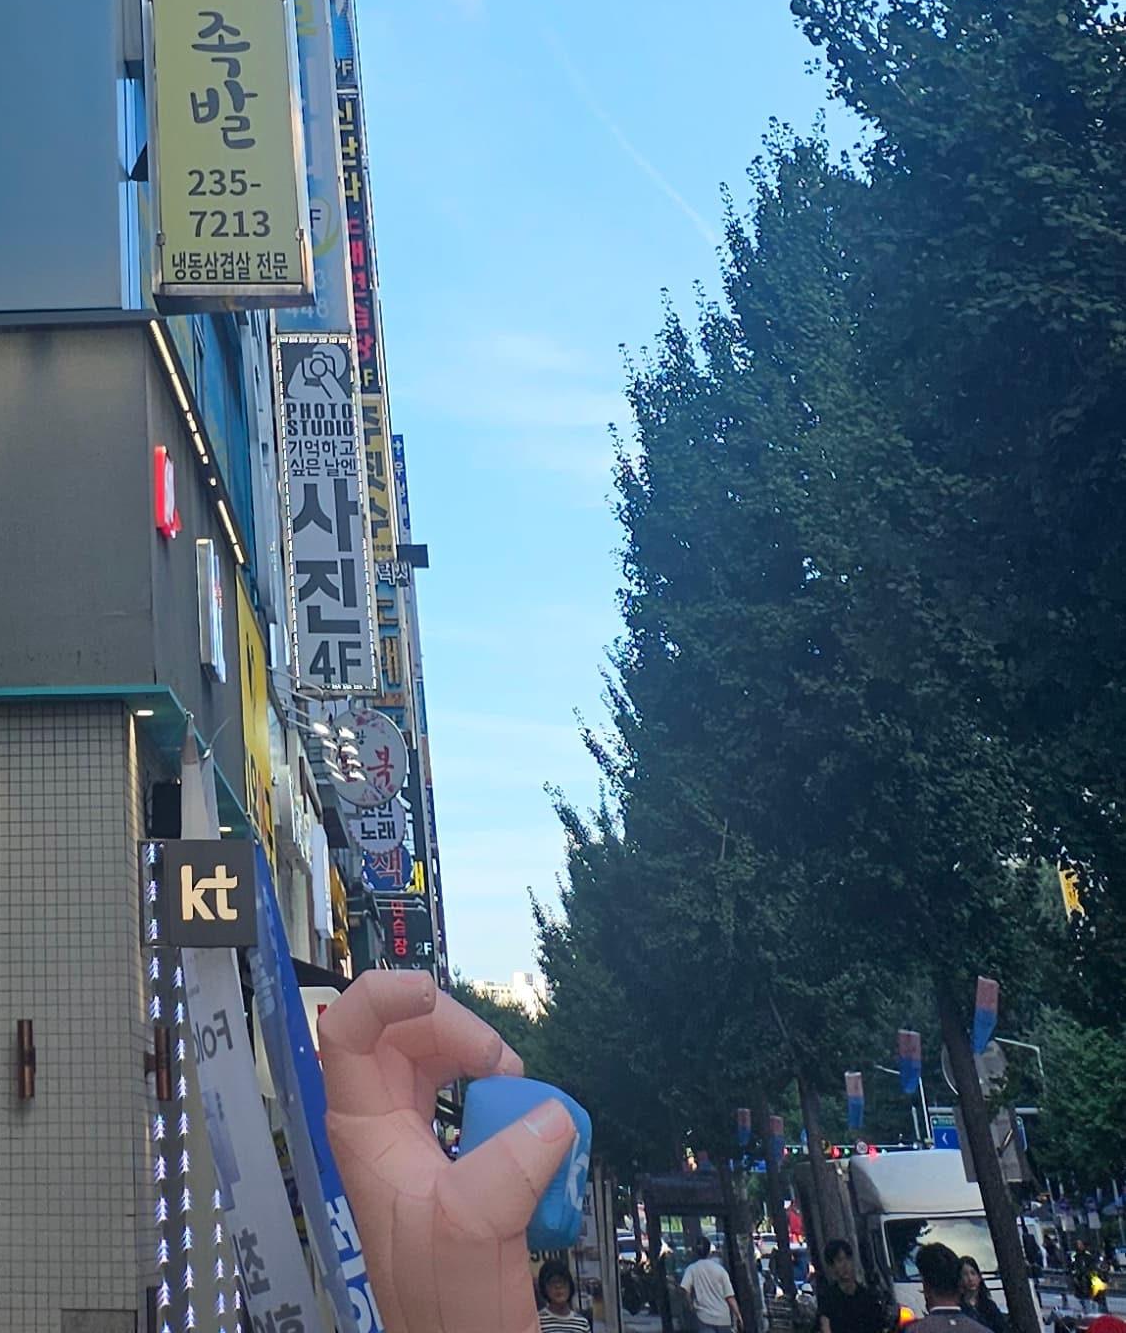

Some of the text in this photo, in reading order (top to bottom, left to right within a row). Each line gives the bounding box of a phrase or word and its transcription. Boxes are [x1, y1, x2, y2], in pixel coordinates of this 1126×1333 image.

[190, 10, 259, 150] 족발
[187, 169, 262, 198] 235-
[187, 209, 271, 239] 7213
[171, 250, 252, 281] 냉동삼겹살
[255, 250, 289, 281] 전문
[286, 402, 353, 420] PHOTO
[287, 419, 355, 437] STUDIO
[288, 439, 357, 458] 기억하고
[290, 457, 357, 478] 싶은 날엔
[292, 478, 360, 635] 사진
[308, 640, 363, 686] 4F
[360, 818, 396, 840] 노래
[179, 864, 238, 922] kt
[415, 941, 433, 956] 2F
